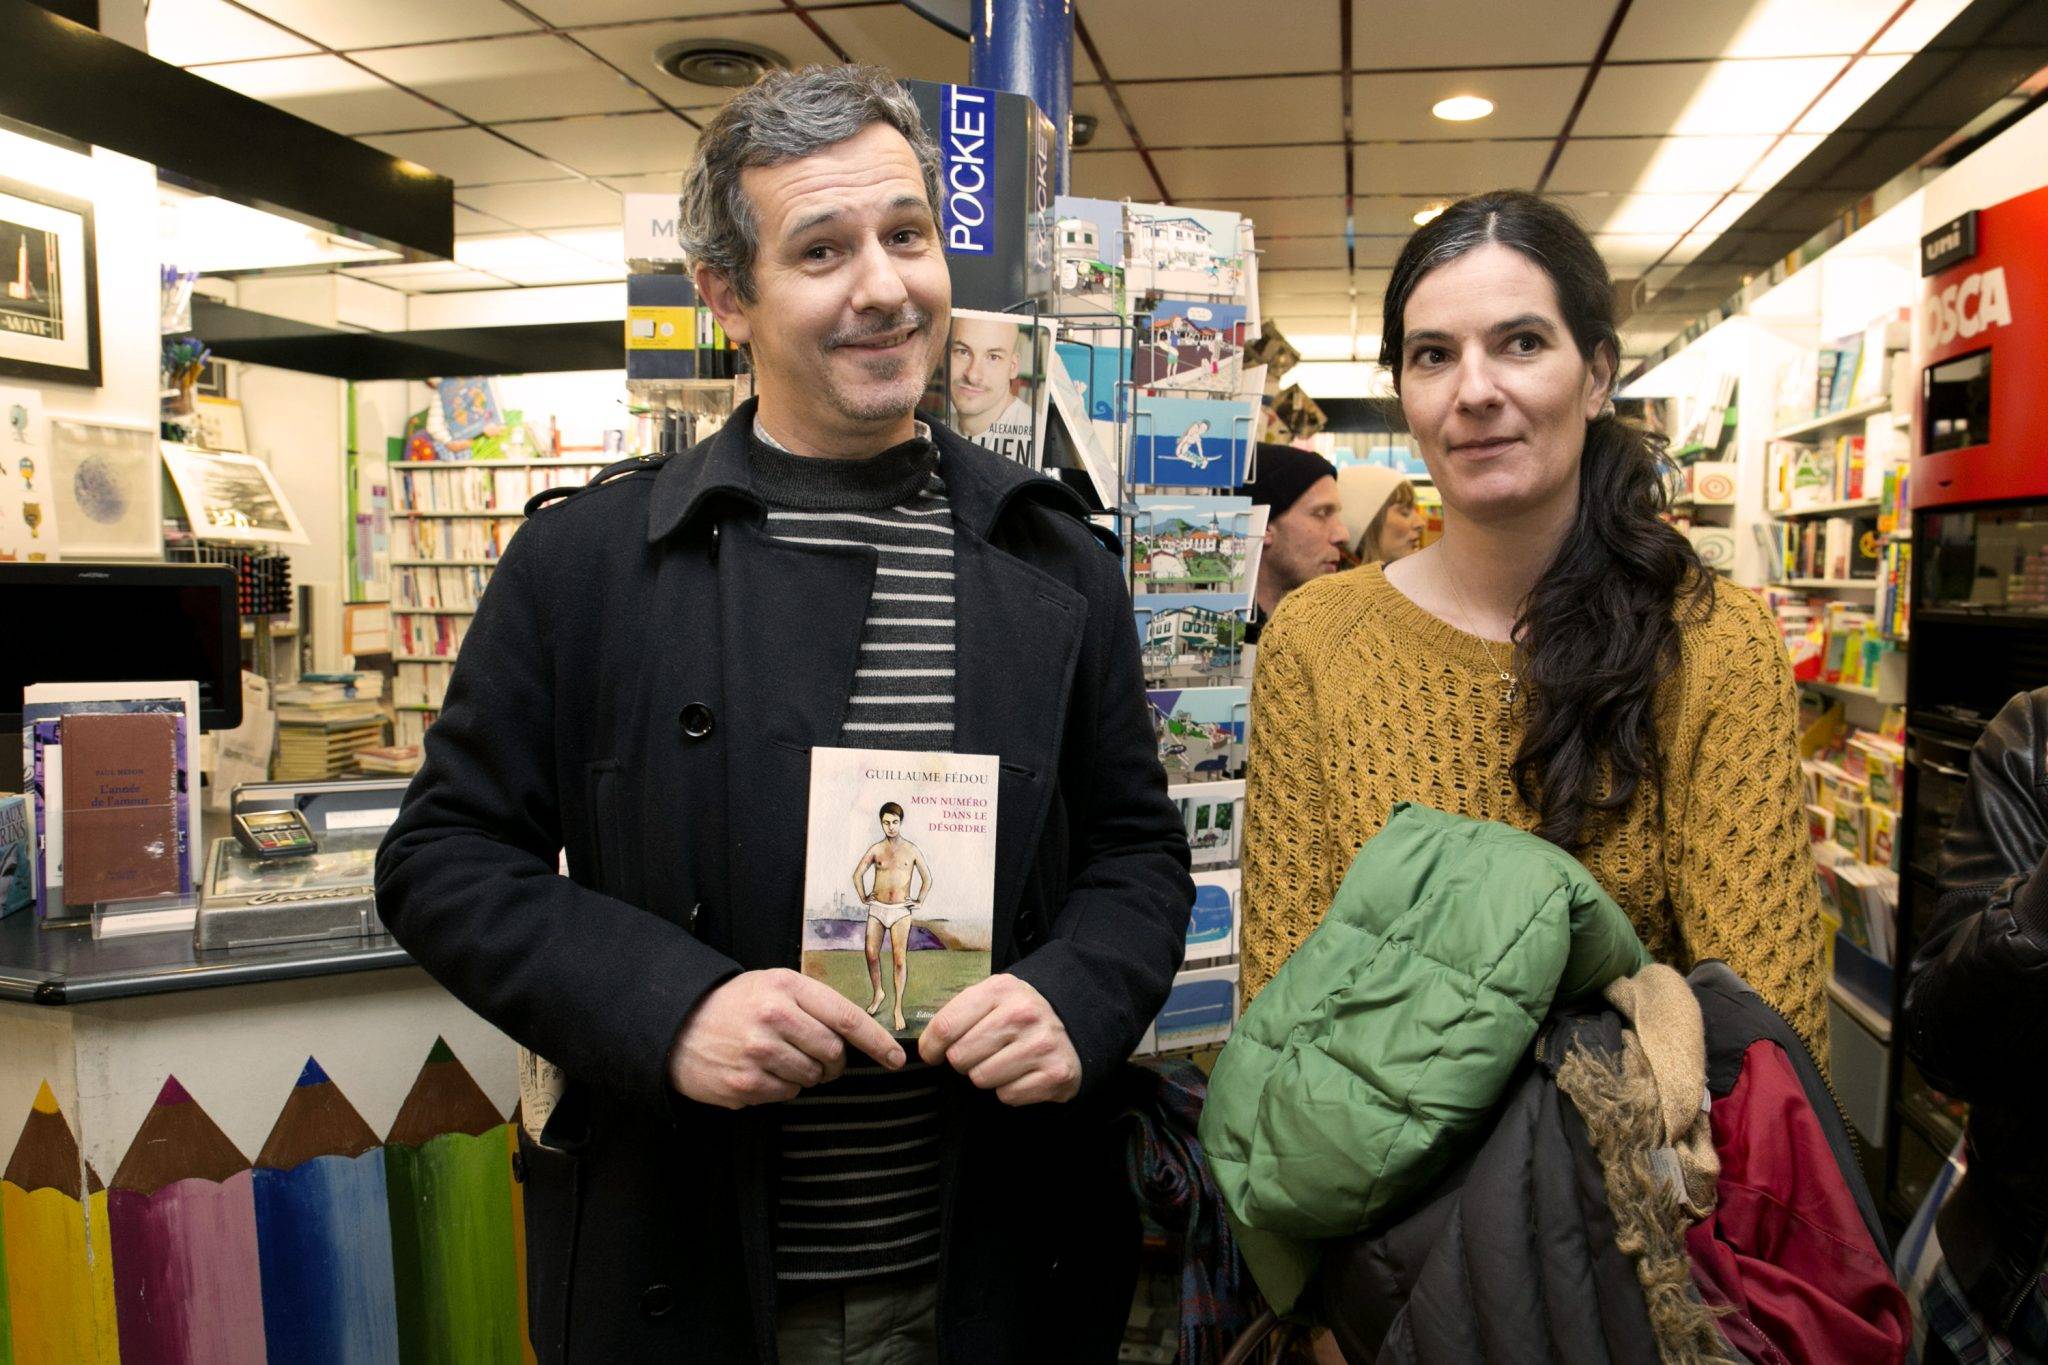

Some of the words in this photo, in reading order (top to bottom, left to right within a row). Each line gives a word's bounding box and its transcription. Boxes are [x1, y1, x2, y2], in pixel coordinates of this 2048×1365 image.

[950, 84, 985, 251] POCKET
[1925, 220, 1961, 260] uni
[1925, 266, 2012, 349] OSCA
[865, 769, 941, 783] GUILLAUME
[945, 771, 989, 785] FÉDOU
[100, 783, 140, 795] L'année
[91, 796, 105, 807] de
[107, 796, 150, 807] l'amour
[911, 796, 937, 805] MON
[940, 796, 988, 808] NUMÉRO
[943, 810, 971, 820] DANS
[974, 811, 988, 821] LE
[929, 822, 988, 834] DÉSORDRE
